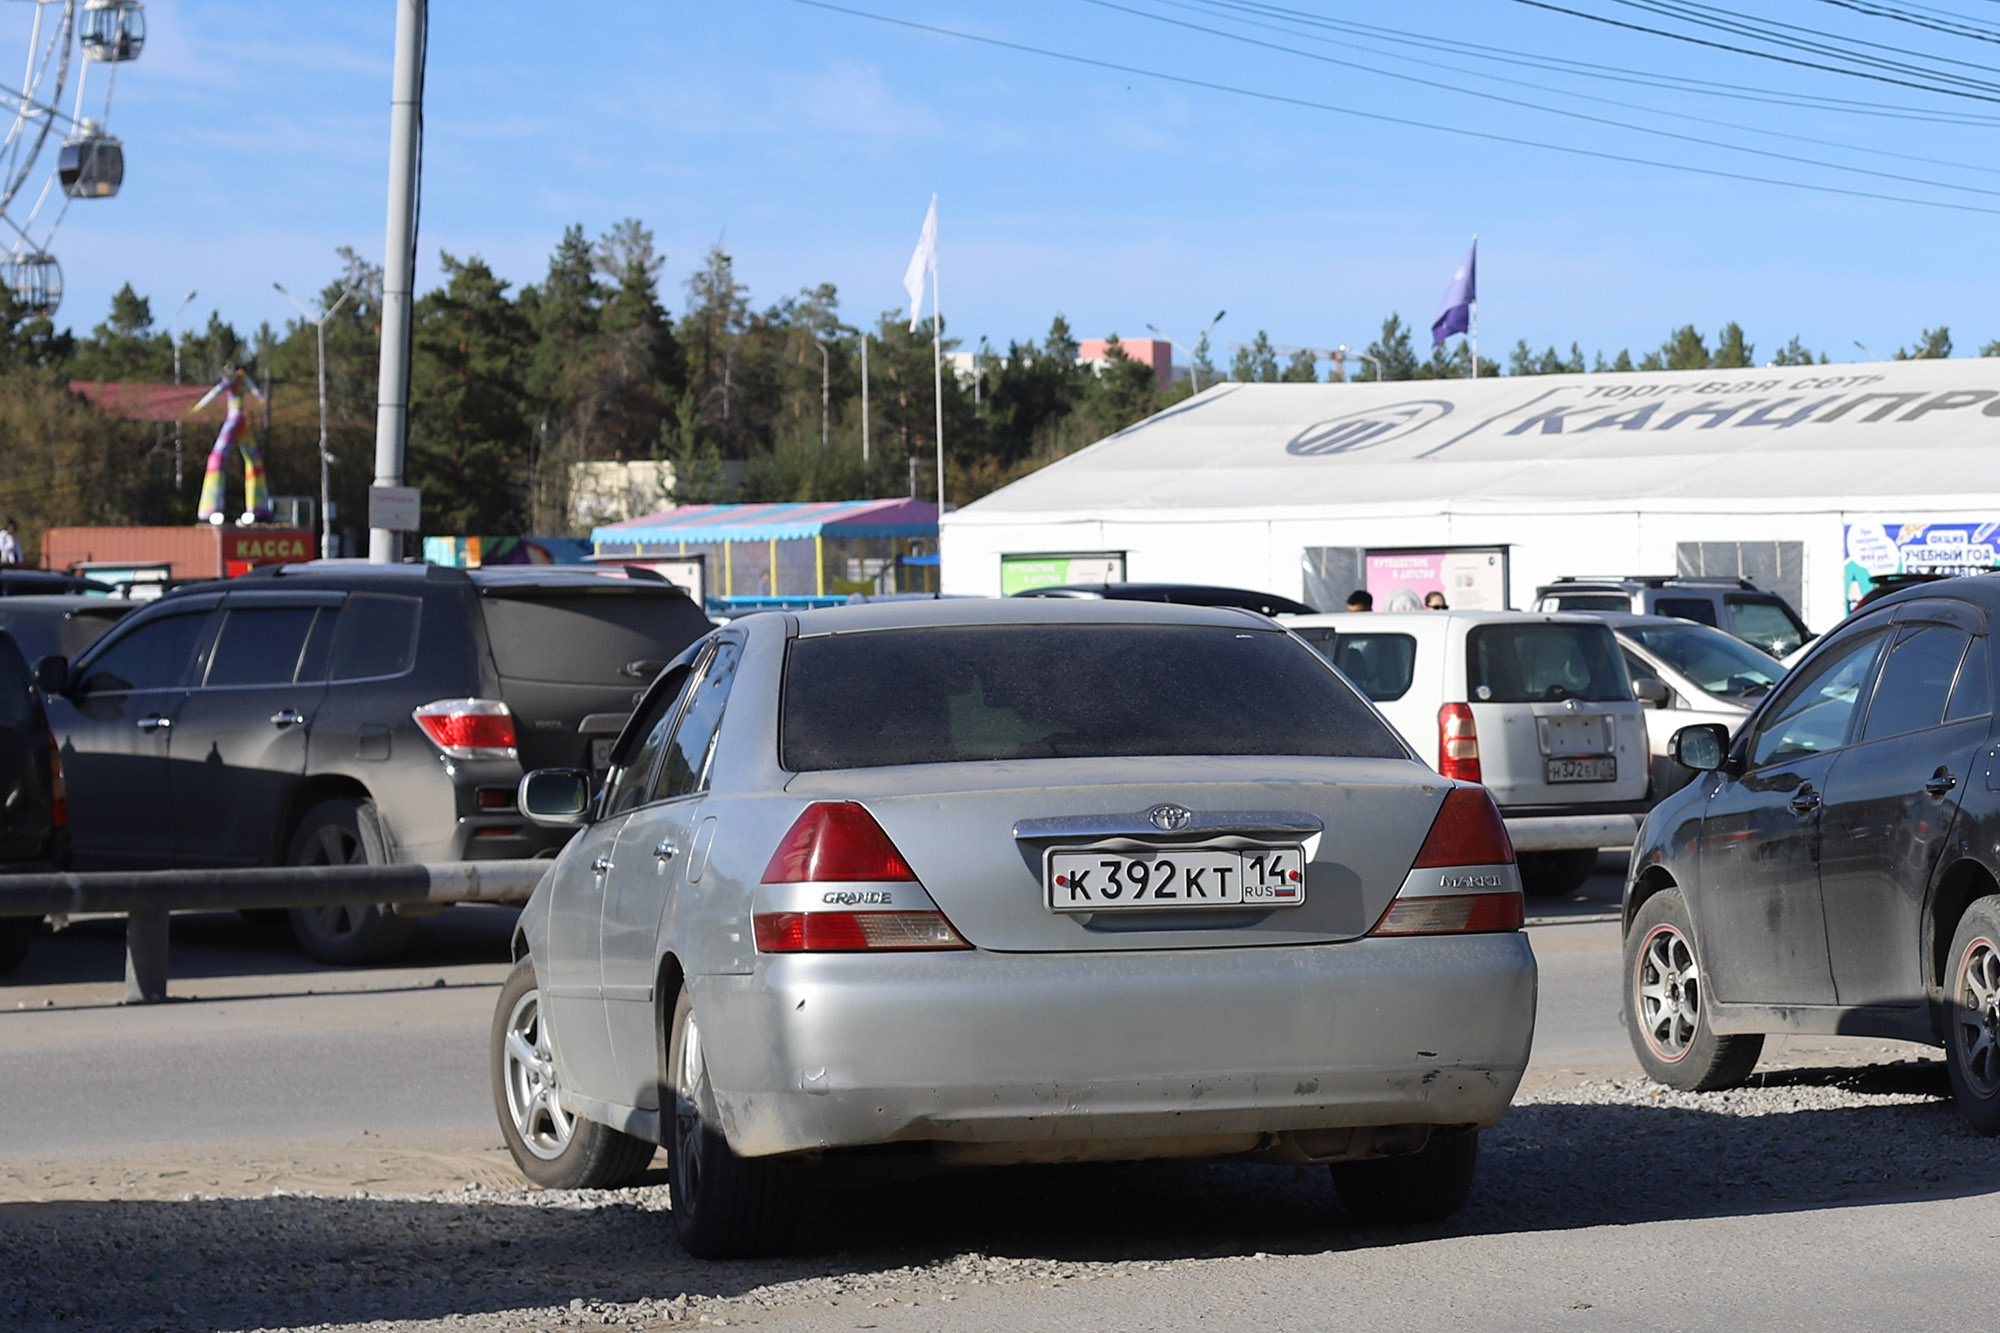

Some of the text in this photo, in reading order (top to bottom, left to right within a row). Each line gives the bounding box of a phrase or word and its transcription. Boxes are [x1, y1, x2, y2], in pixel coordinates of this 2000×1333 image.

[1502, 388, 2000, 436] КАНЦПР
[236, 540, 304, 557] КАССА
[1905, 547, 1962, 562] УЧЕБНЫЙ
[1966, 549, 1991, 562] ГОД
[1249, 855, 1287, 886] 14
[1069, 859, 1233, 901] К392КТ
[822, 891, 893, 906] GRANDE
[1245, 886, 1273, 898] RUS
